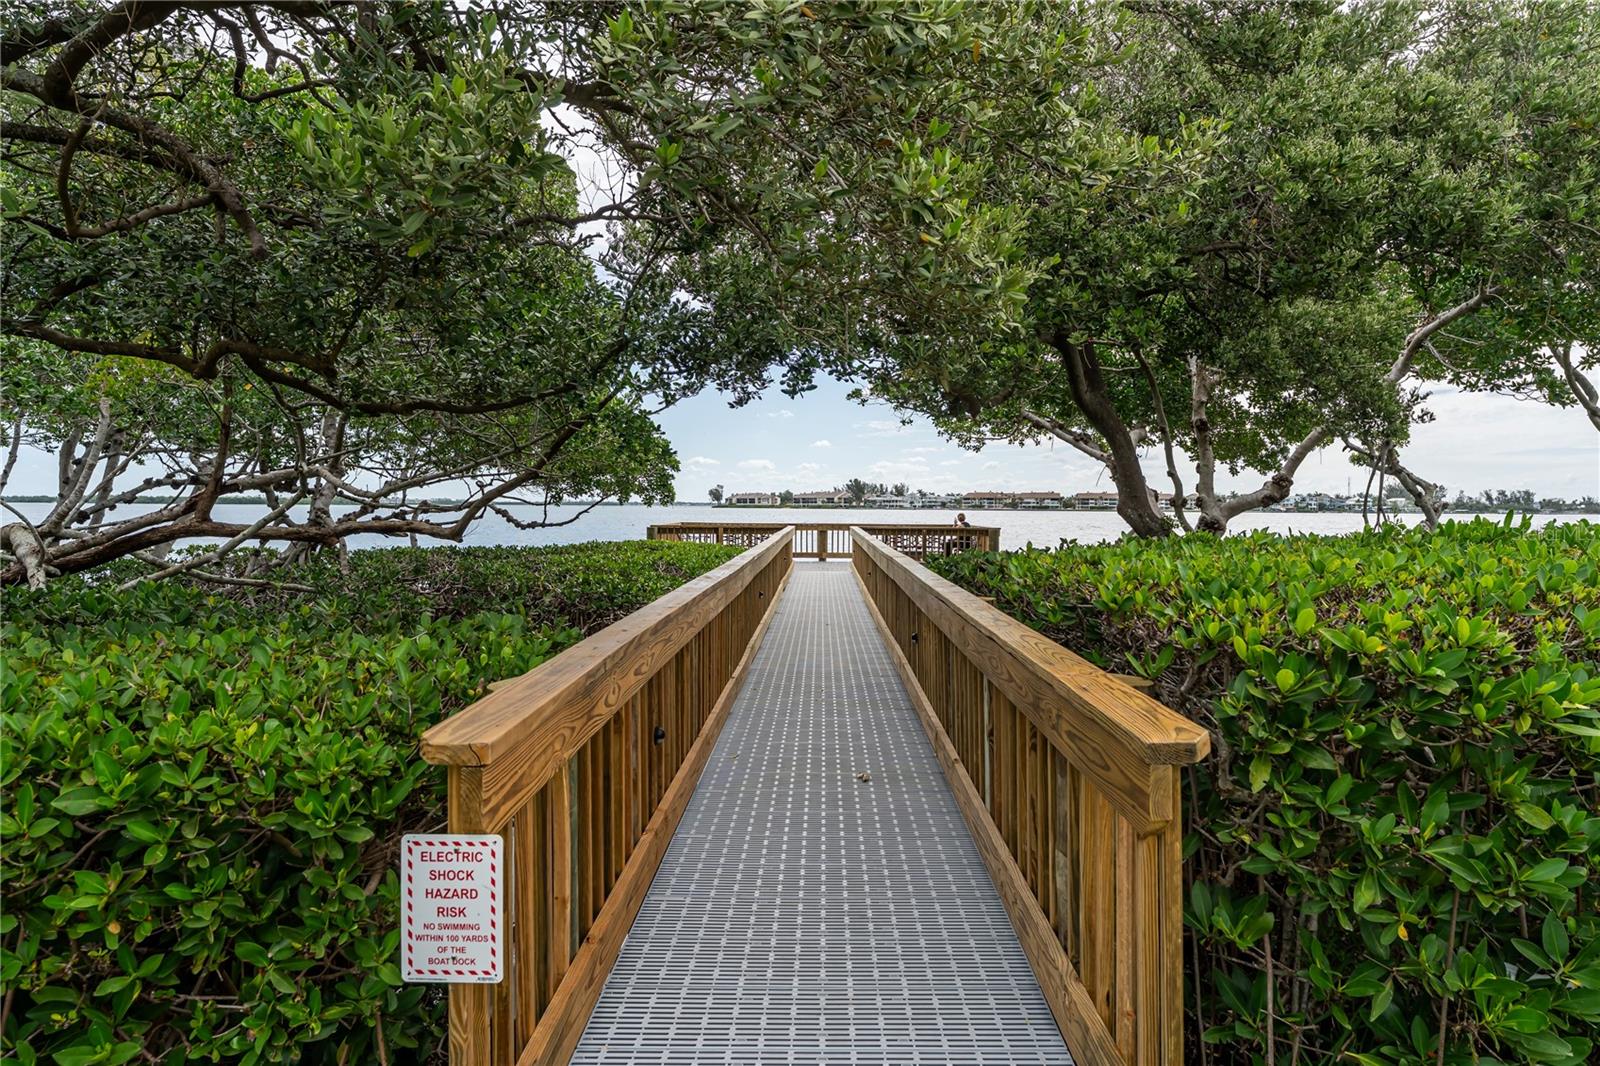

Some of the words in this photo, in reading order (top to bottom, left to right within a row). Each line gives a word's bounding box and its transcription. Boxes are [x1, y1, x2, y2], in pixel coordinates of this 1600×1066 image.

[420, 851, 483, 862] ELECTRIC
[429, 870, 475, 881] SHOCK
[425, 888, 479, 899] HAZARD
[436, 906, 467, 918] RISK
[423, 922, 436, 931] NO
[437, 923, 481, 931] SWIMMING
[415, 934, 444, 942] WITHIN
[446, 934, 459, 942] 100
[461, 935, 489, 943] YARDS
[437, 946, 448, 954] OF
[450, 946, 467, 954] THE
[428, 957, 450, 965] BOAT
[452, 957, 476, 966] DOCK
